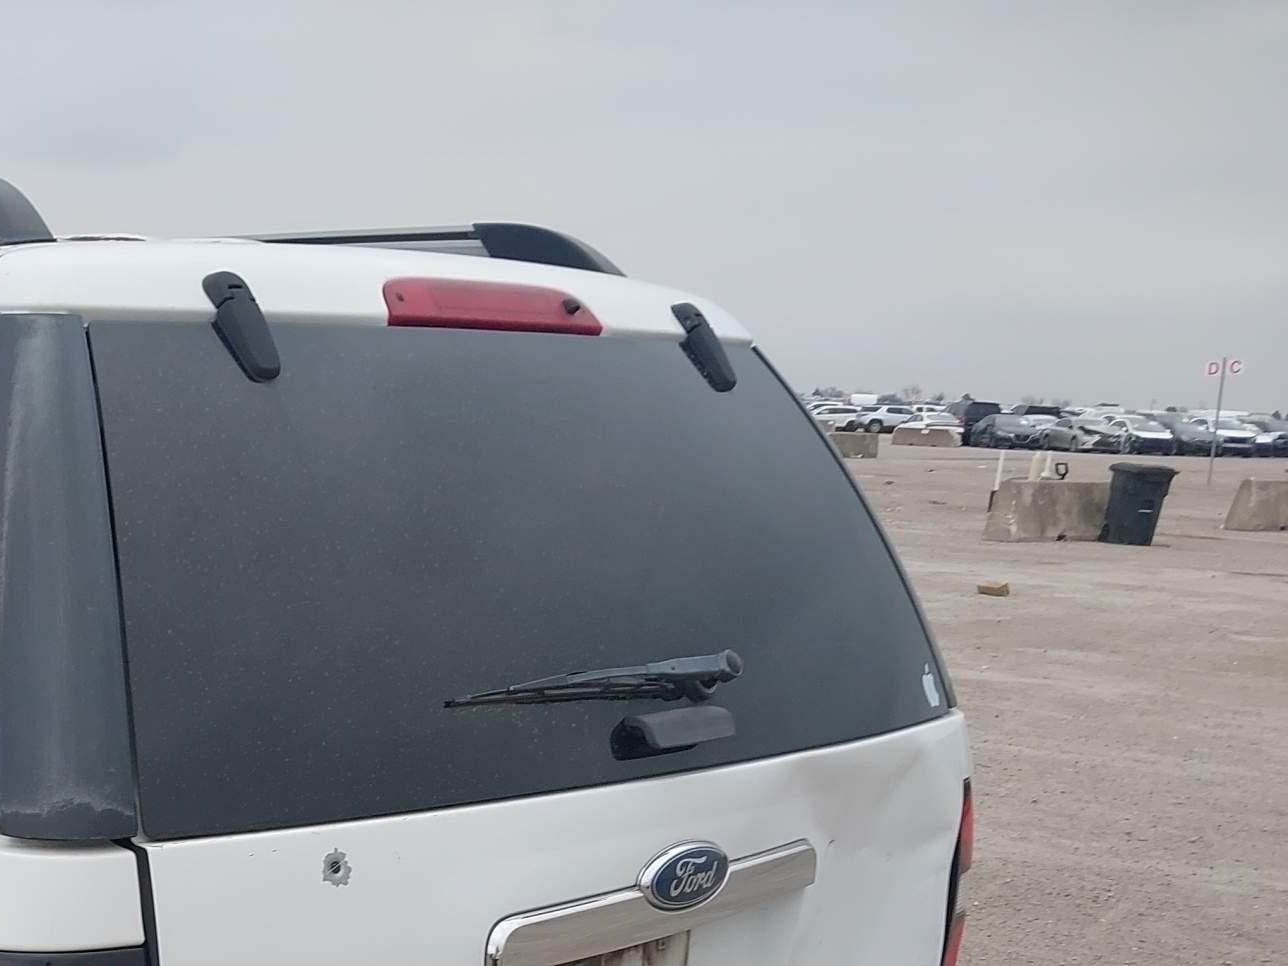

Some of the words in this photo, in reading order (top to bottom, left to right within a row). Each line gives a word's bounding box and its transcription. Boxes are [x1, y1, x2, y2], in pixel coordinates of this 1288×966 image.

[1208, 361, 1220, 375] D
[1230, 360, 1242, 374] C
[669, 855, 719, 897] Ford
